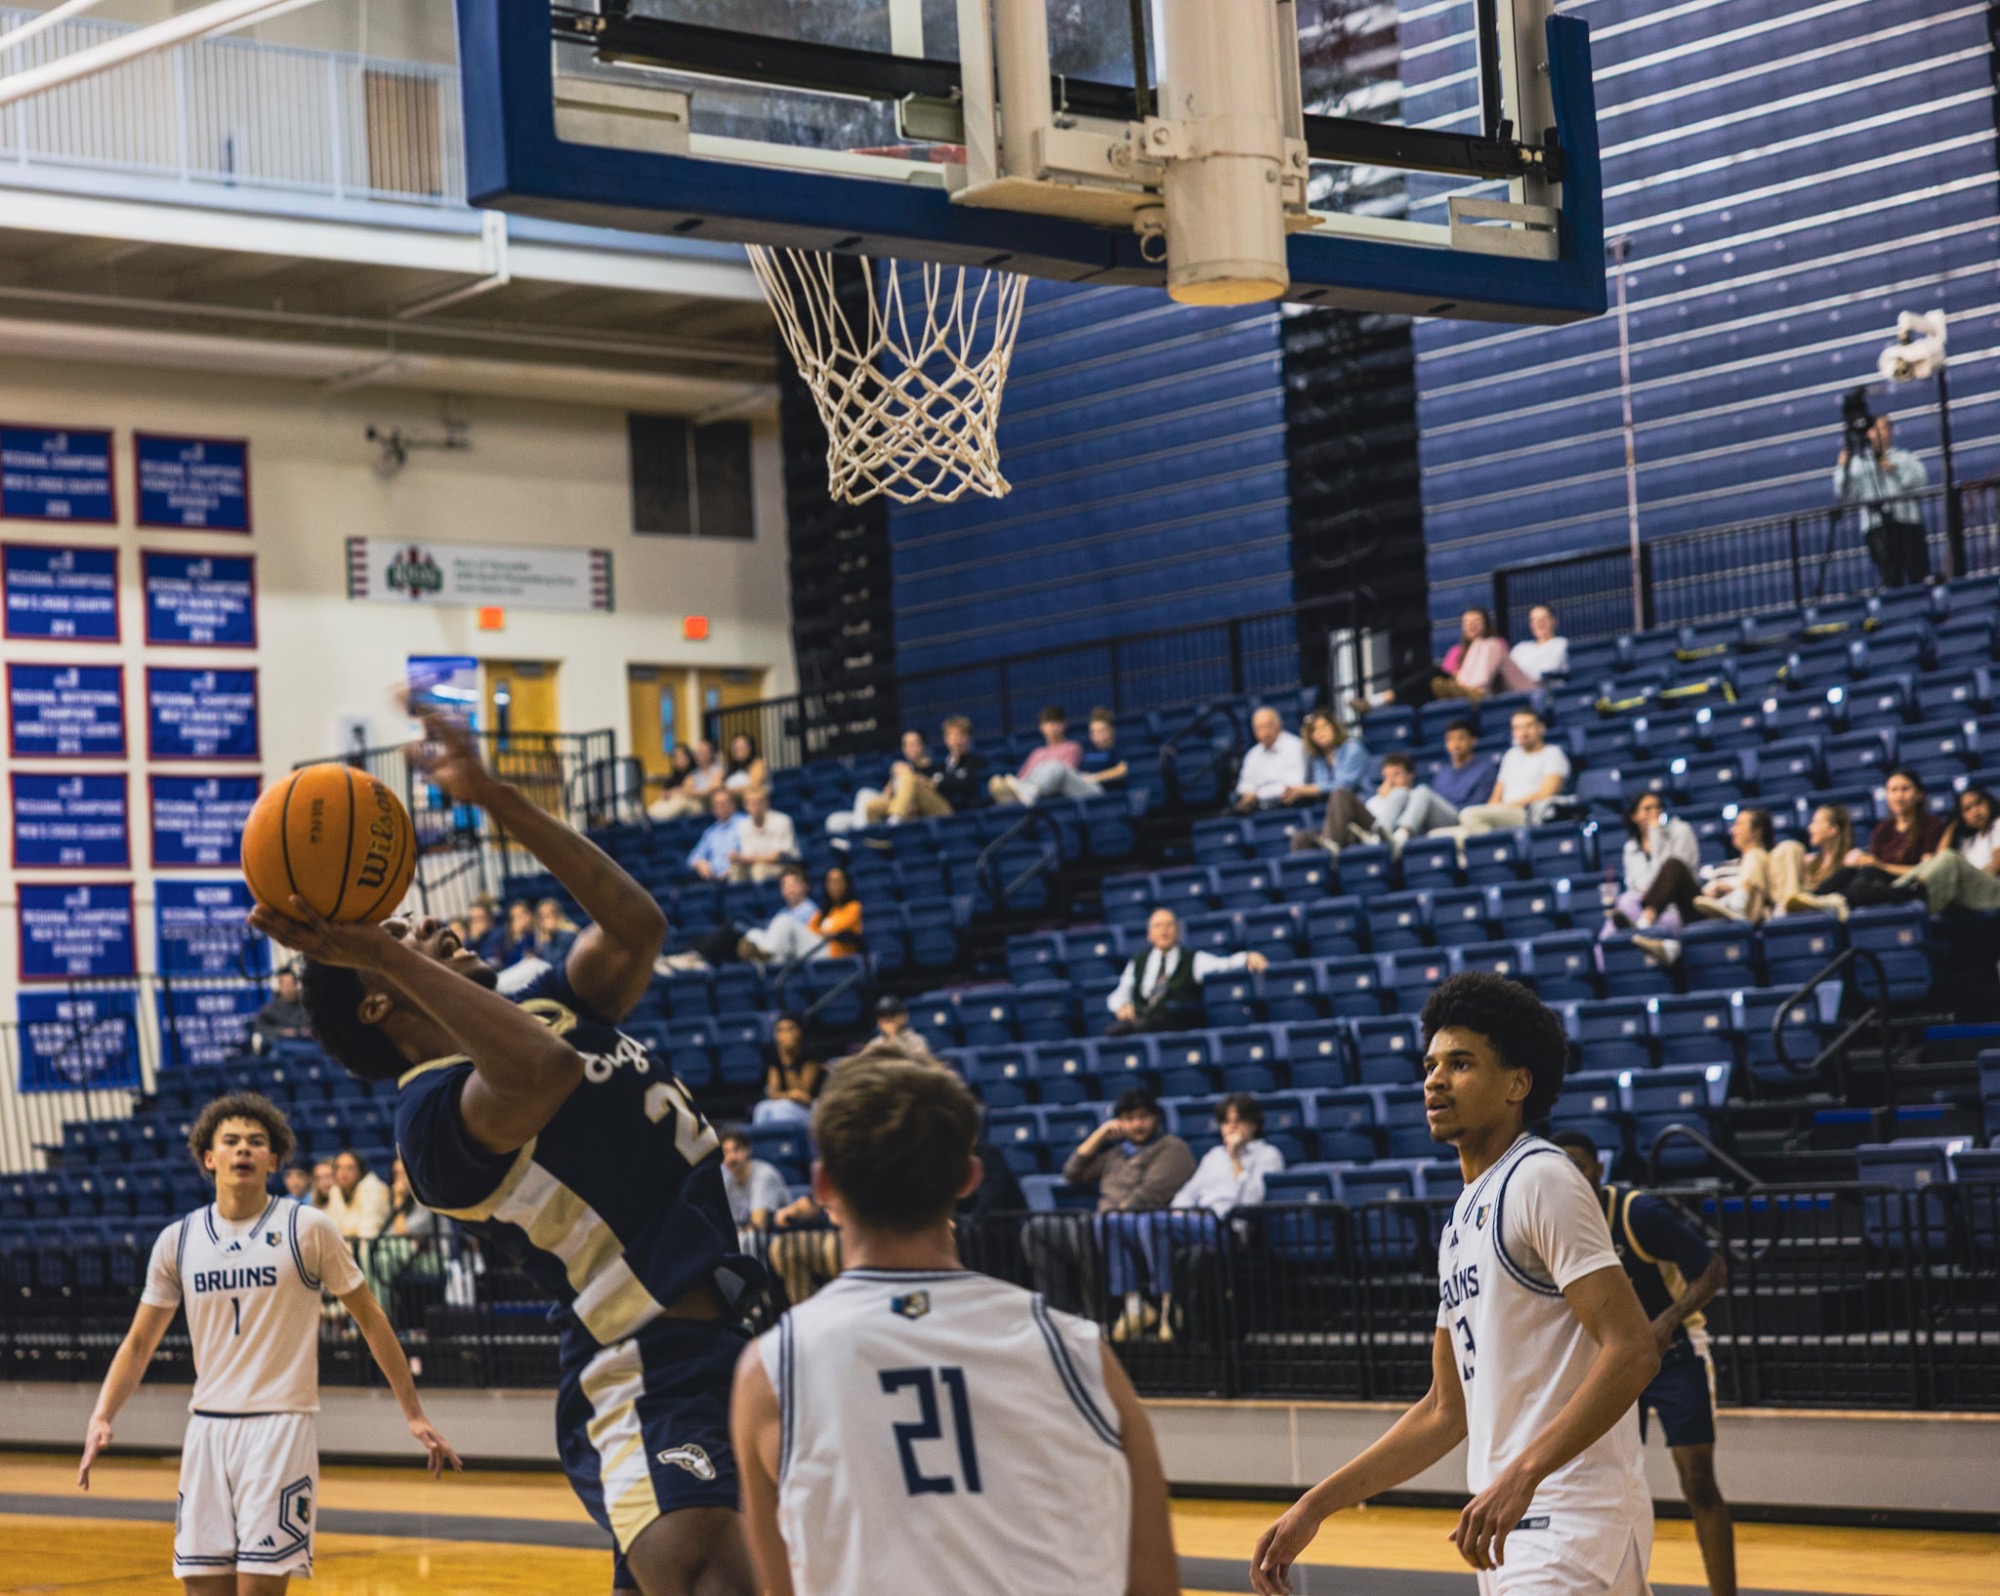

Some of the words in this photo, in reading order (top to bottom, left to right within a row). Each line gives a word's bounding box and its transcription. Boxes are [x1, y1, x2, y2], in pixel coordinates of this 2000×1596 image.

[357, 782, 394, 888] Wilson
[194, 1266, 277, 1293] BRUINS
[231, 1297, 240, 1336] 1
[878, 1366, 983, 1496] 21
